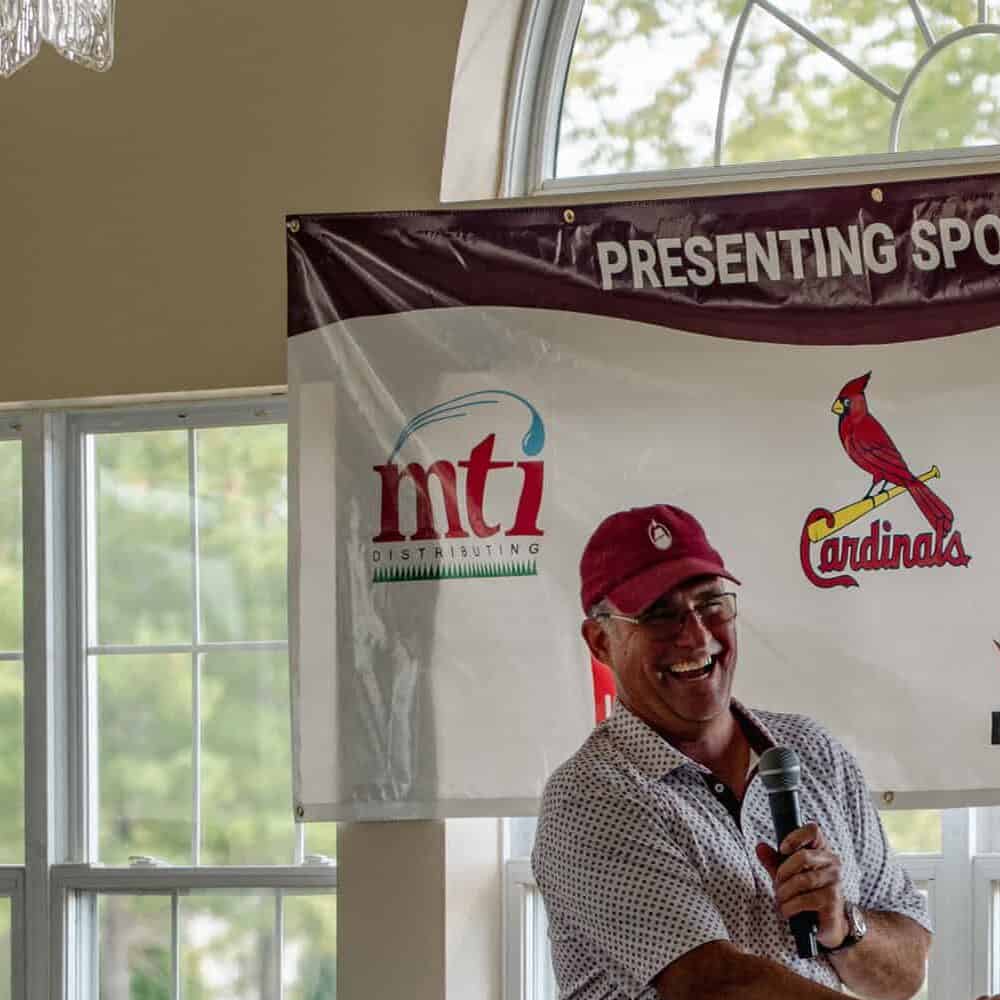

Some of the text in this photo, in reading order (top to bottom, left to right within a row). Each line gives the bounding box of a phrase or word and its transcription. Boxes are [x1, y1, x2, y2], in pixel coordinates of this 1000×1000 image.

[595, 221, 898, 291] PRESENTING
[372, 433, 545, 544] mti
[372, 543, 540, 562] DISTRIBUTING
[800, 507, 972, 589] Cardinals
